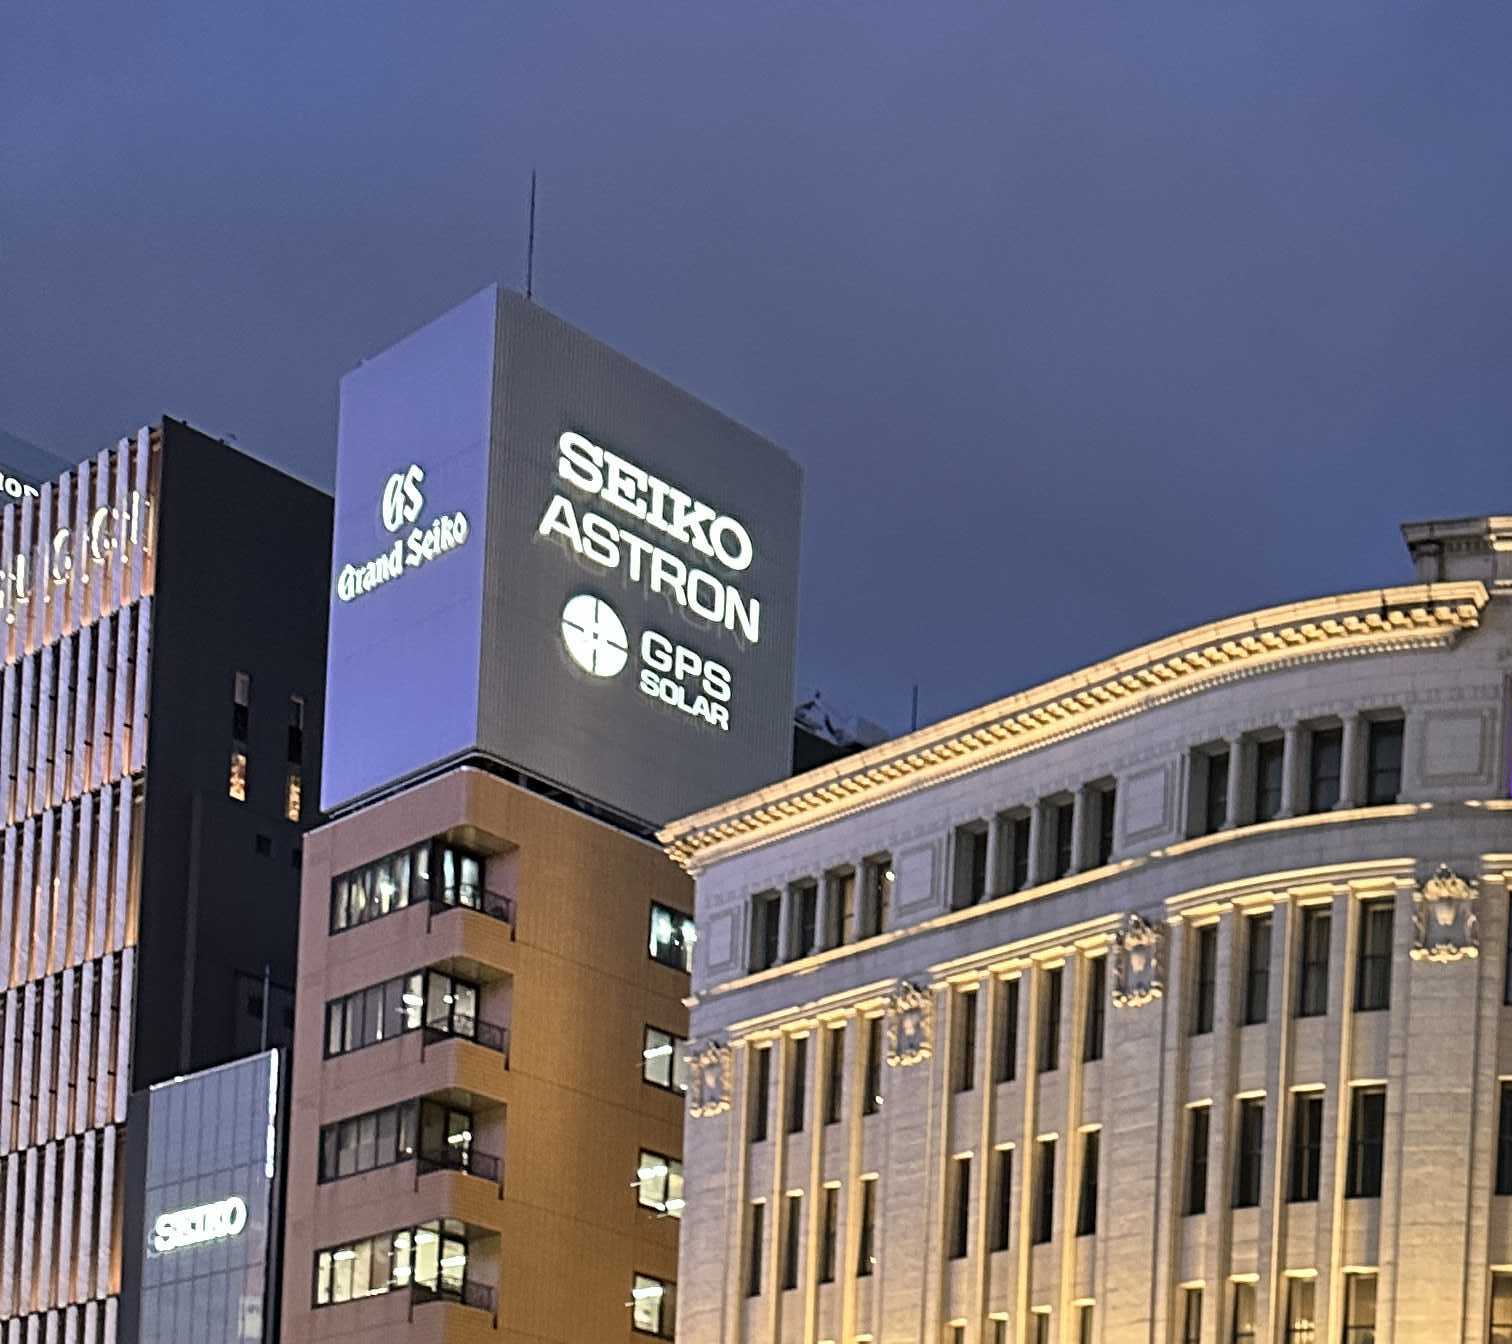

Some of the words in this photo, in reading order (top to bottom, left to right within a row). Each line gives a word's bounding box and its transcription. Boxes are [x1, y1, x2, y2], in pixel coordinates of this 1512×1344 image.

[382, 464, 425, 532] GS
[558, 431, 754, 571] SEIKO
[337, 539, 403, 601] Grand
[405, 511, 468, 567] Seiko
[538, 494, 760, 643] ASTRON
[639, 668, 730, 731] SOLAR
[640, 629, 732, 702] GPS
